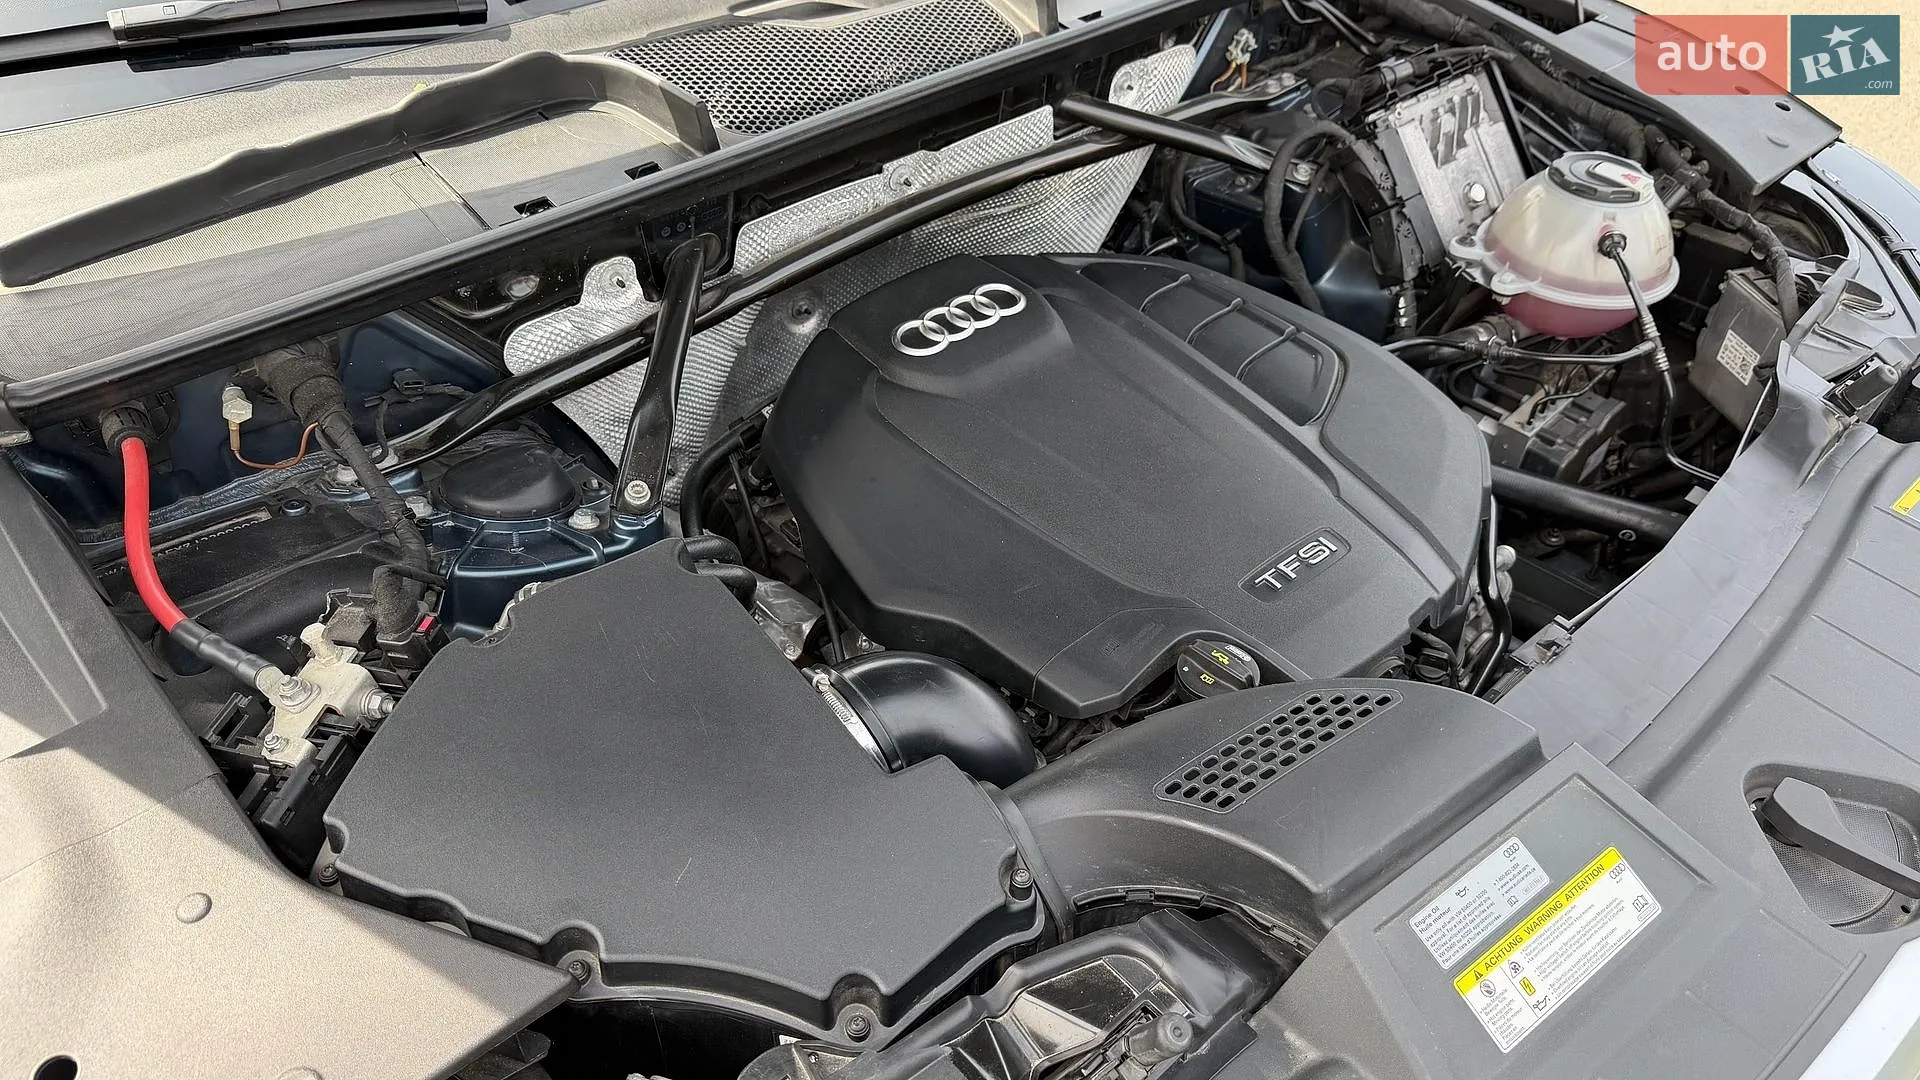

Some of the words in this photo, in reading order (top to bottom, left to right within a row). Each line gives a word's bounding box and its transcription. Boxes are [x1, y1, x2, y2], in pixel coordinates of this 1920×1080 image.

[1253, 536, 1338, 592] TFSI
[1414, 911, 1432, 928] Engine
[1430, 905, 1439, 913] Oil
[1419, 921, 1433, 934] Huile
[1431, 906, 1451, 923] moteur
[1482, 934, 1523, 971] ACHTUNG
[1523, 899, 1563, 935] WARNING
[1563, 863, 1605, 901] ATTENTION
